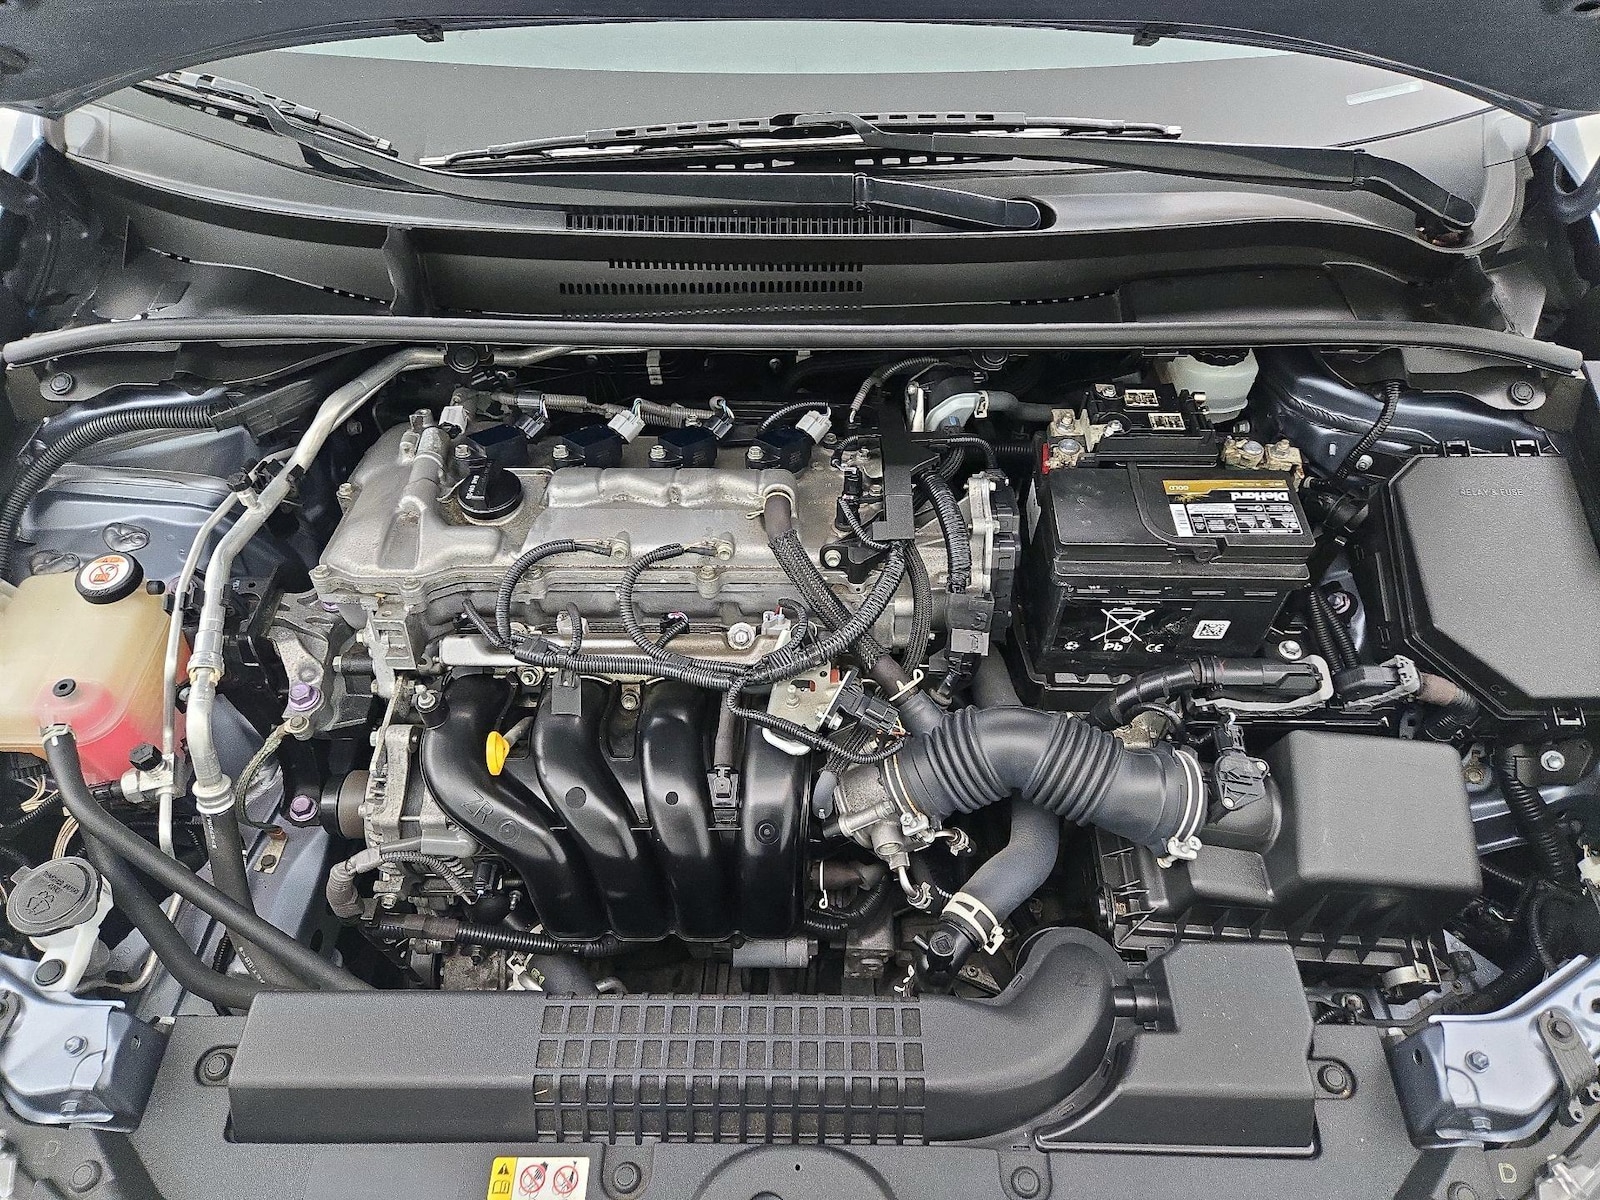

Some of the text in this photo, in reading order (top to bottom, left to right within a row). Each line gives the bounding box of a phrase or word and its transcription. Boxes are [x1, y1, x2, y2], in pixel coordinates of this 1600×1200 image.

[1231, 491, 1289, 501] DieHard
[1460, 488, 1488, 496] RELAY
[1500, 488, 1523, 496] FUSE
[1103, 643, 1123, 651] Pb
[1145, 644, 1164, 652] CE
[460, 789, 494, 825] ZR
